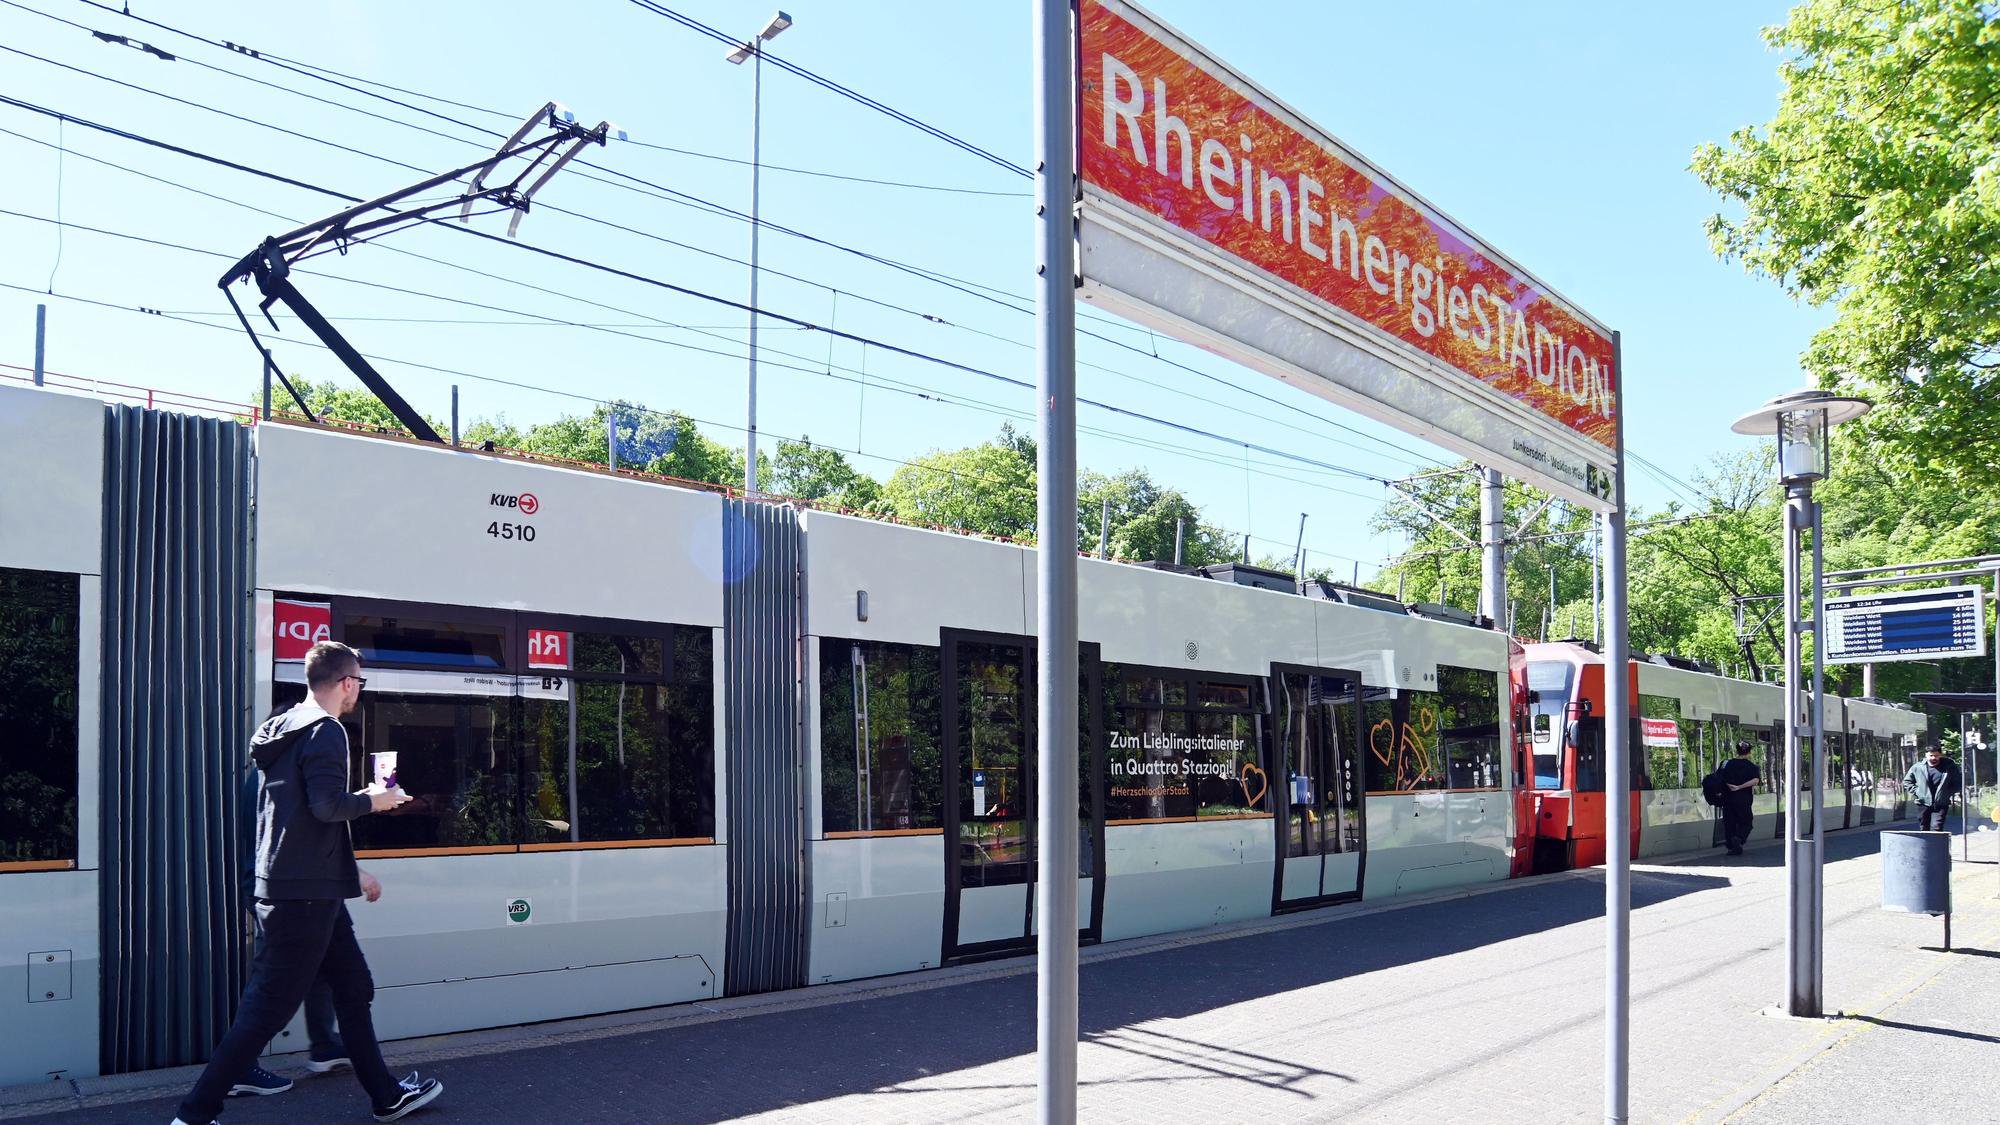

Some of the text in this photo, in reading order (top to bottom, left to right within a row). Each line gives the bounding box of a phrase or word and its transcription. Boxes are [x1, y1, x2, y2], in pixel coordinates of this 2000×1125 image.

[1102, 52, 1610, 420] RheinEnergieSTADION
[490, 493, 518, 508] KVB
[487, 521, 536, 542] 4510
[1110, 731, 1244, 754] Zum Lieblingsitaliener
[1111, 758, 1233, 775] in Quattro Stazioni!
[1111, 785, 1190, 797] #HerzschlagDerStadt
[508, 904, 525, 913] VRS
